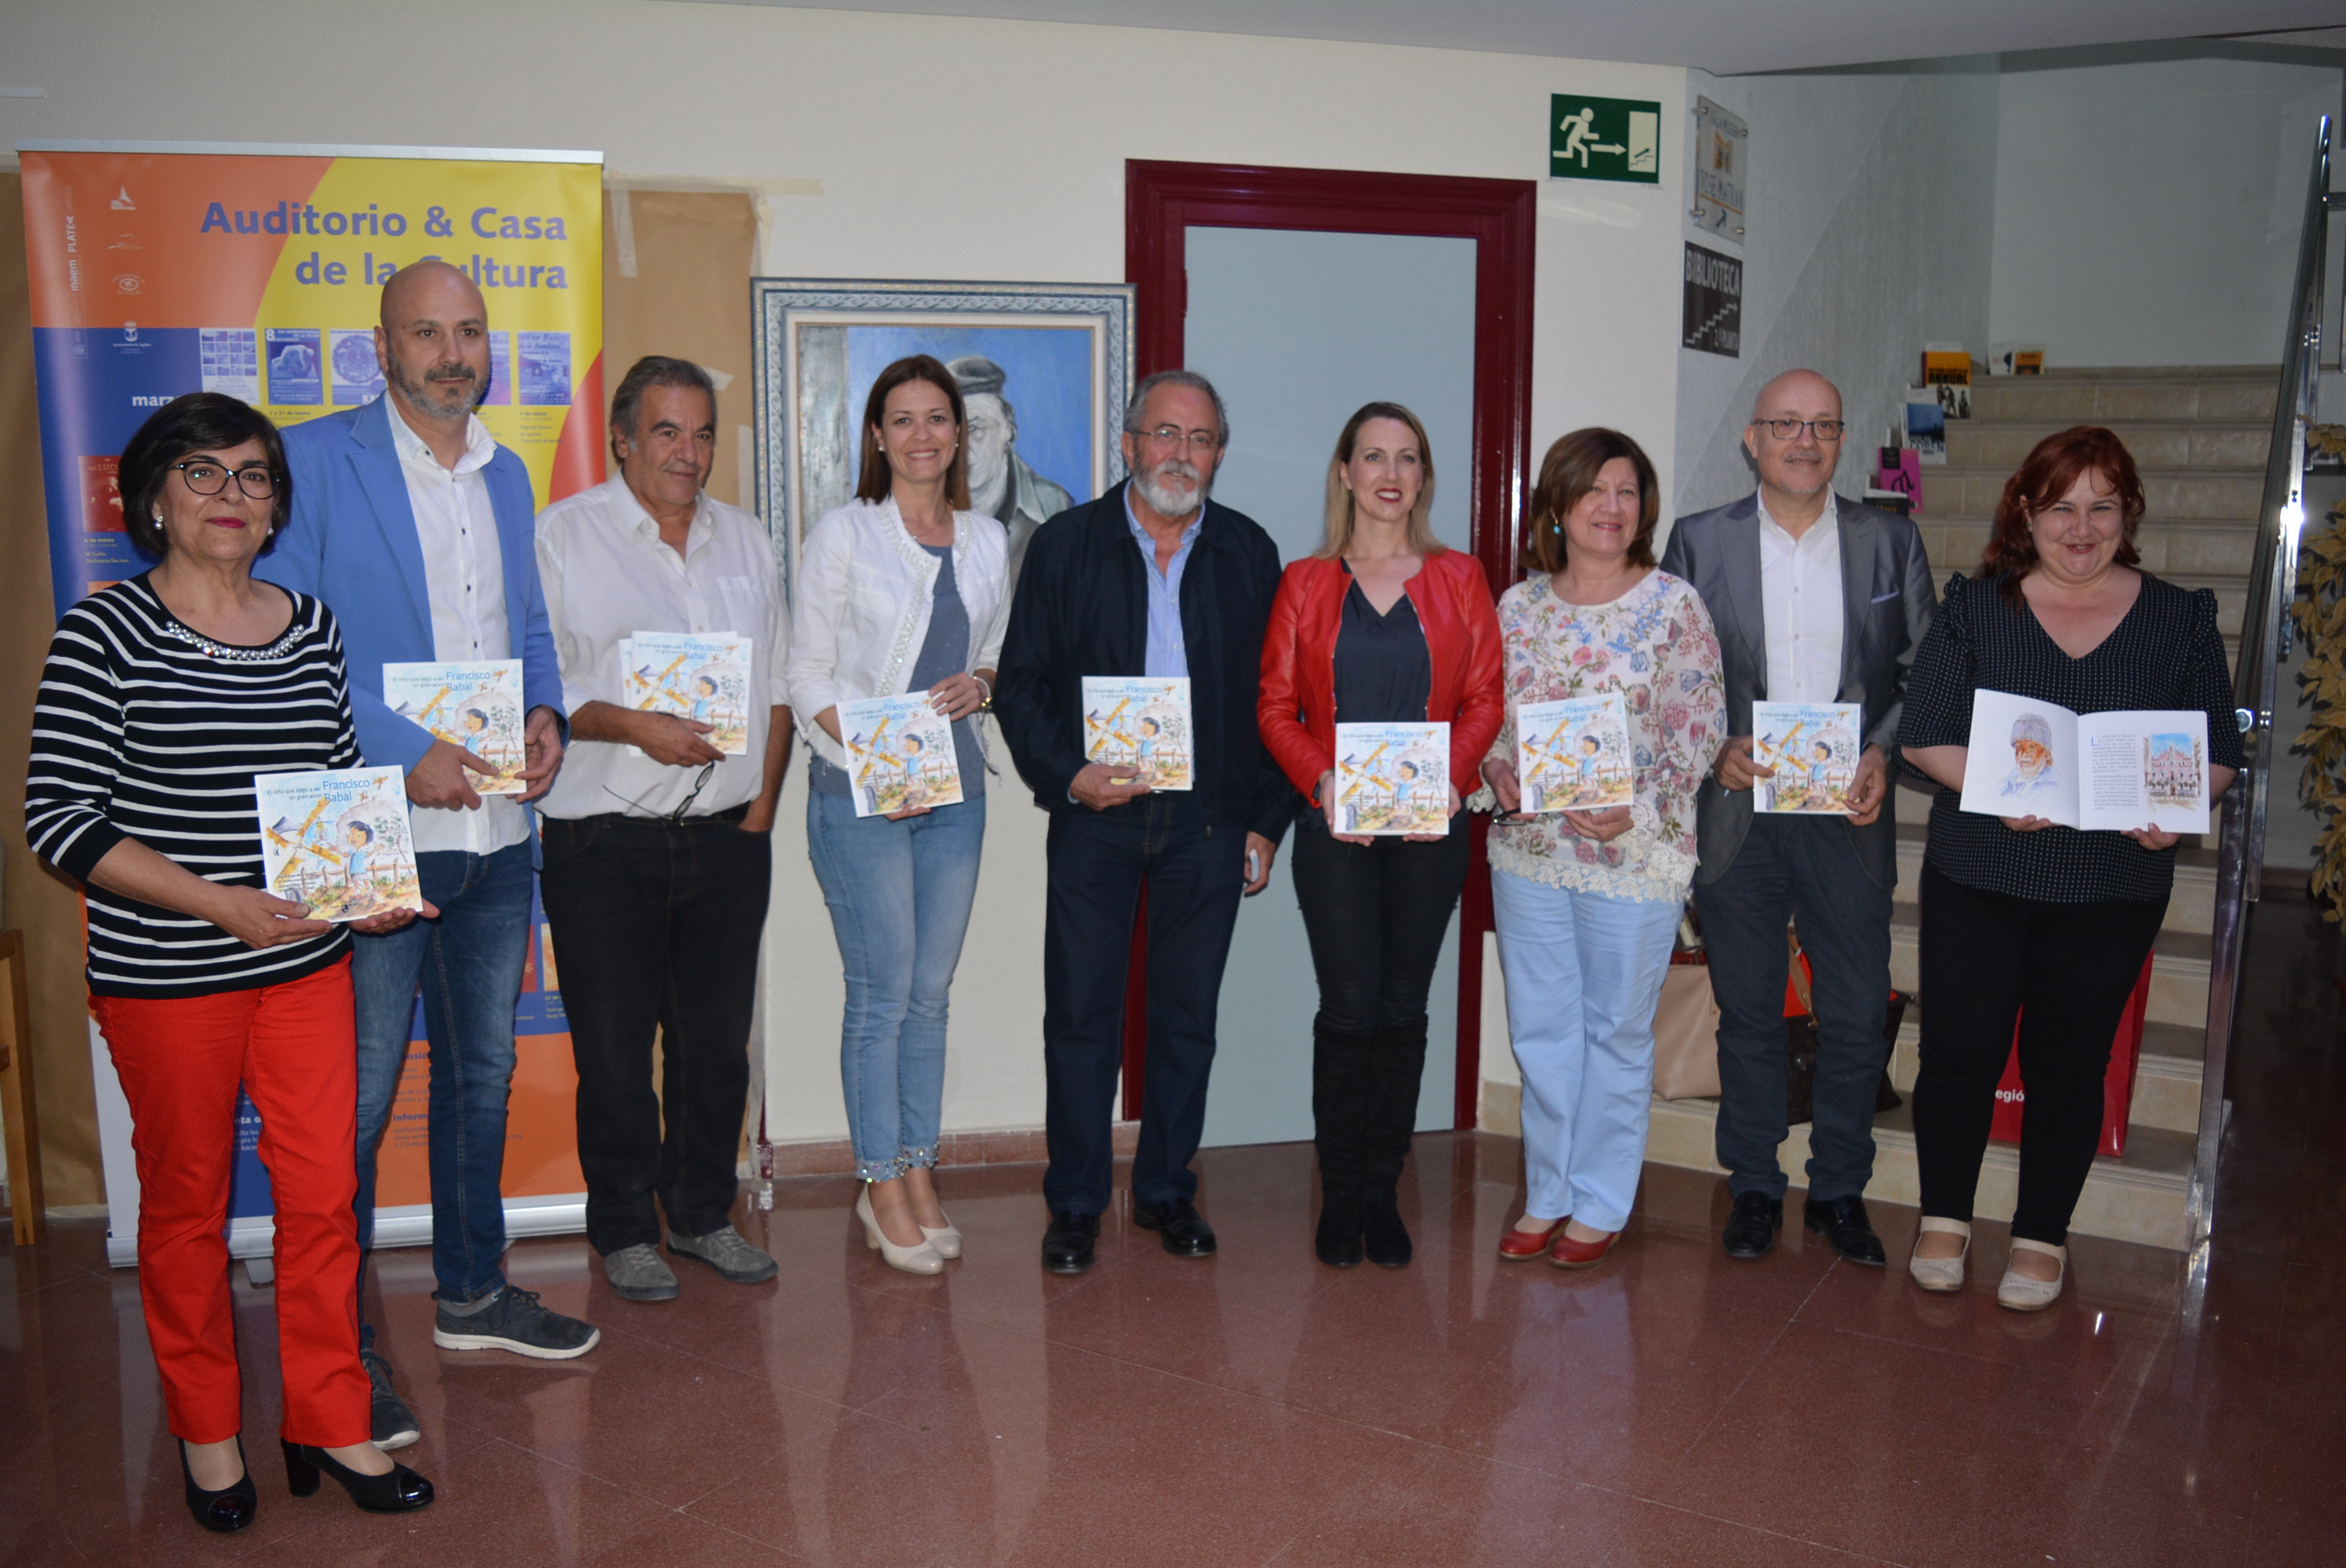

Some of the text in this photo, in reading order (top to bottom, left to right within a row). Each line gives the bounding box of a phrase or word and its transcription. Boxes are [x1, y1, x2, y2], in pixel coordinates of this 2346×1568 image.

[199, 201, 568, 241] Auditorio & Casa
[295, 252, 568, 289] de la ltura
[1686, 249, 1741, 297] BIBLIOTECA
[266, 328, 275, 341] 8
[132, 395, 183, 407] marz
[684, 641, 723, 652] Francisco
[446, 670, 491, 681] Francisco
[446, 681, 473, 691] Rabal
[1126, 685, 1162, 694] Francisco
[884, 701, 921, 711] Francisco
[1565, 703, 1600, 713] Francisco
[1800, 710, 1836, 718] Francisco
[322, 779, 371, 791] Francisco
[323, 791, 352, 803] Rabal
[1995, 1088, 2025, 1104] egió
